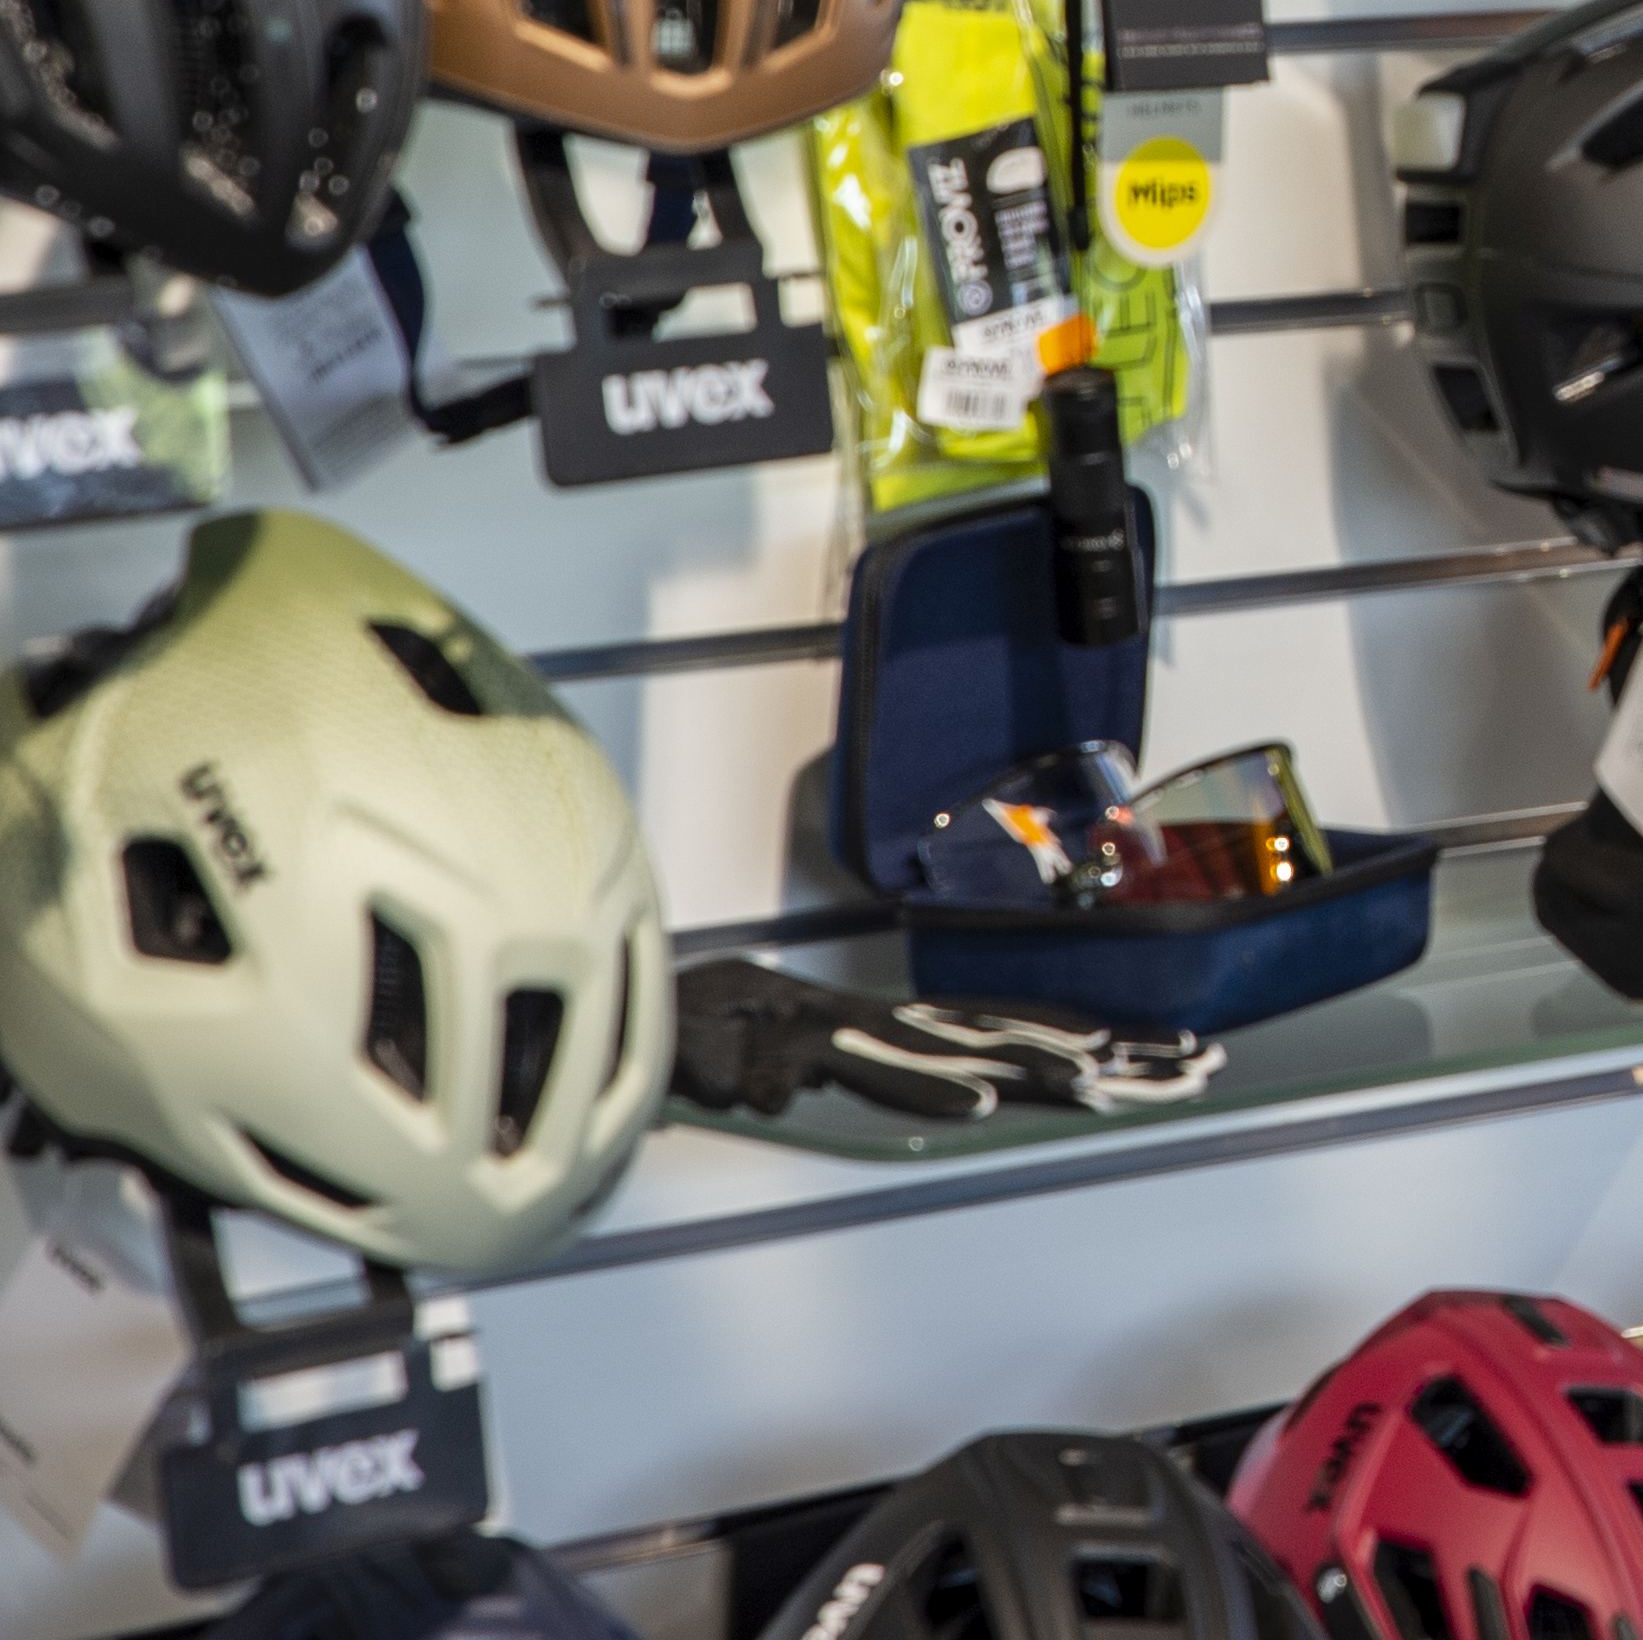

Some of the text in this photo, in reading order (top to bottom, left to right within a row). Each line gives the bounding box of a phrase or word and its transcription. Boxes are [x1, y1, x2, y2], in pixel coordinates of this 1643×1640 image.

[1127, 177, 1199, 210] Mips
[604, 364, 774, 435] uvex
[0, 406, 139, 476] vex
[183, 763, 272, 892] uvex
[239, 1430, 418, 1523] uvex
